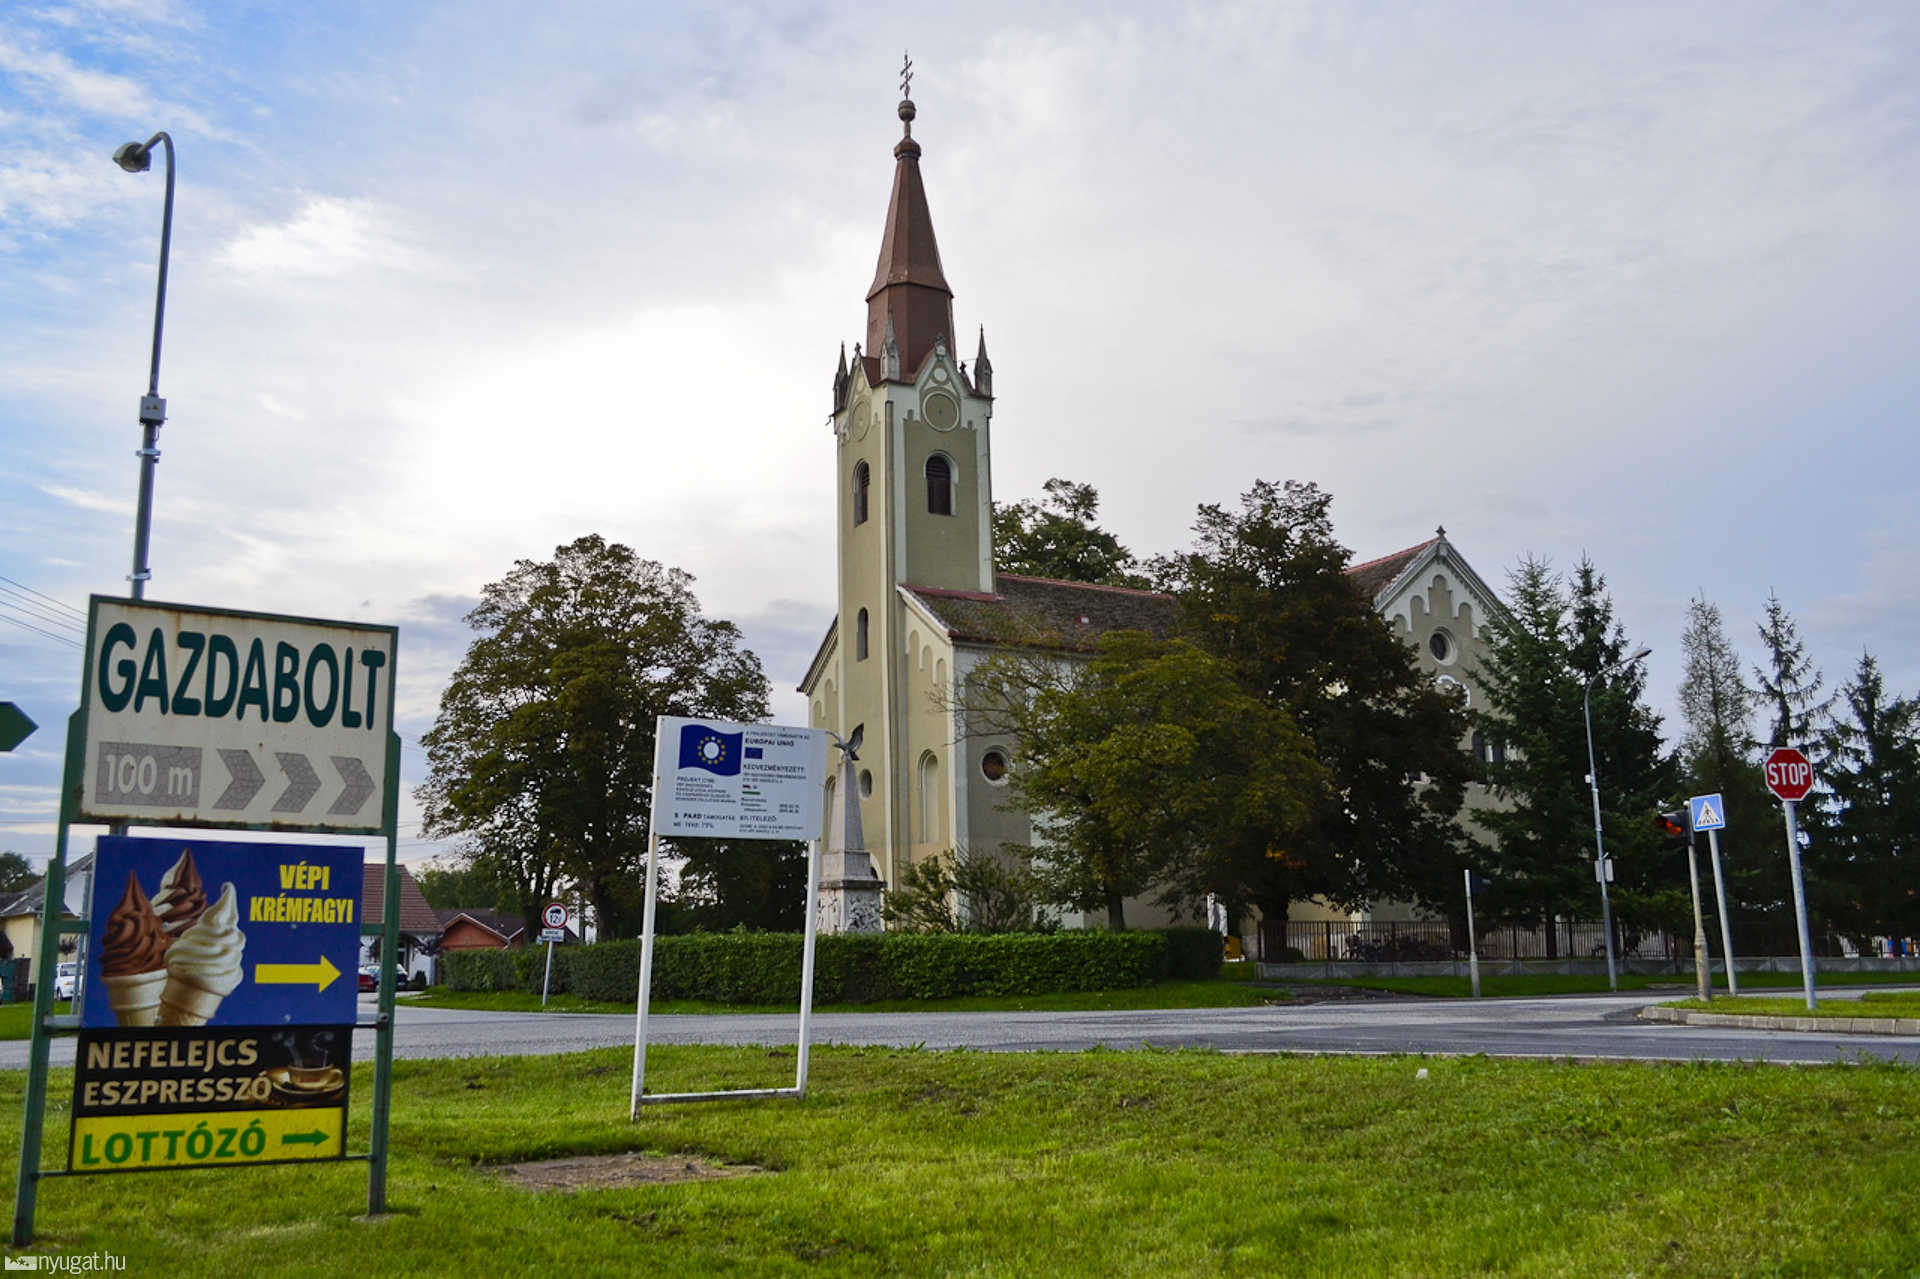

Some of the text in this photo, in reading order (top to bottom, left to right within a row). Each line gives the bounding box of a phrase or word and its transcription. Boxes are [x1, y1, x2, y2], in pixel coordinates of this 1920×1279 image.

[98, 622, 386, 730] GAZDABOLT
[105, 753, 193, 796] 100 m
[1768, 762, 1809, 786] STOP
[279, 860, 330, 890] VÉPI
[249, 892, 353, 924] KRÉMFAGYI
[87, 1039, 258, 1073] NEFELEJCS
[83, 1069, 273, 1107] ESZPRESSZÓ
[81, 1120, 267, 1166] LOTTÓZÓ
